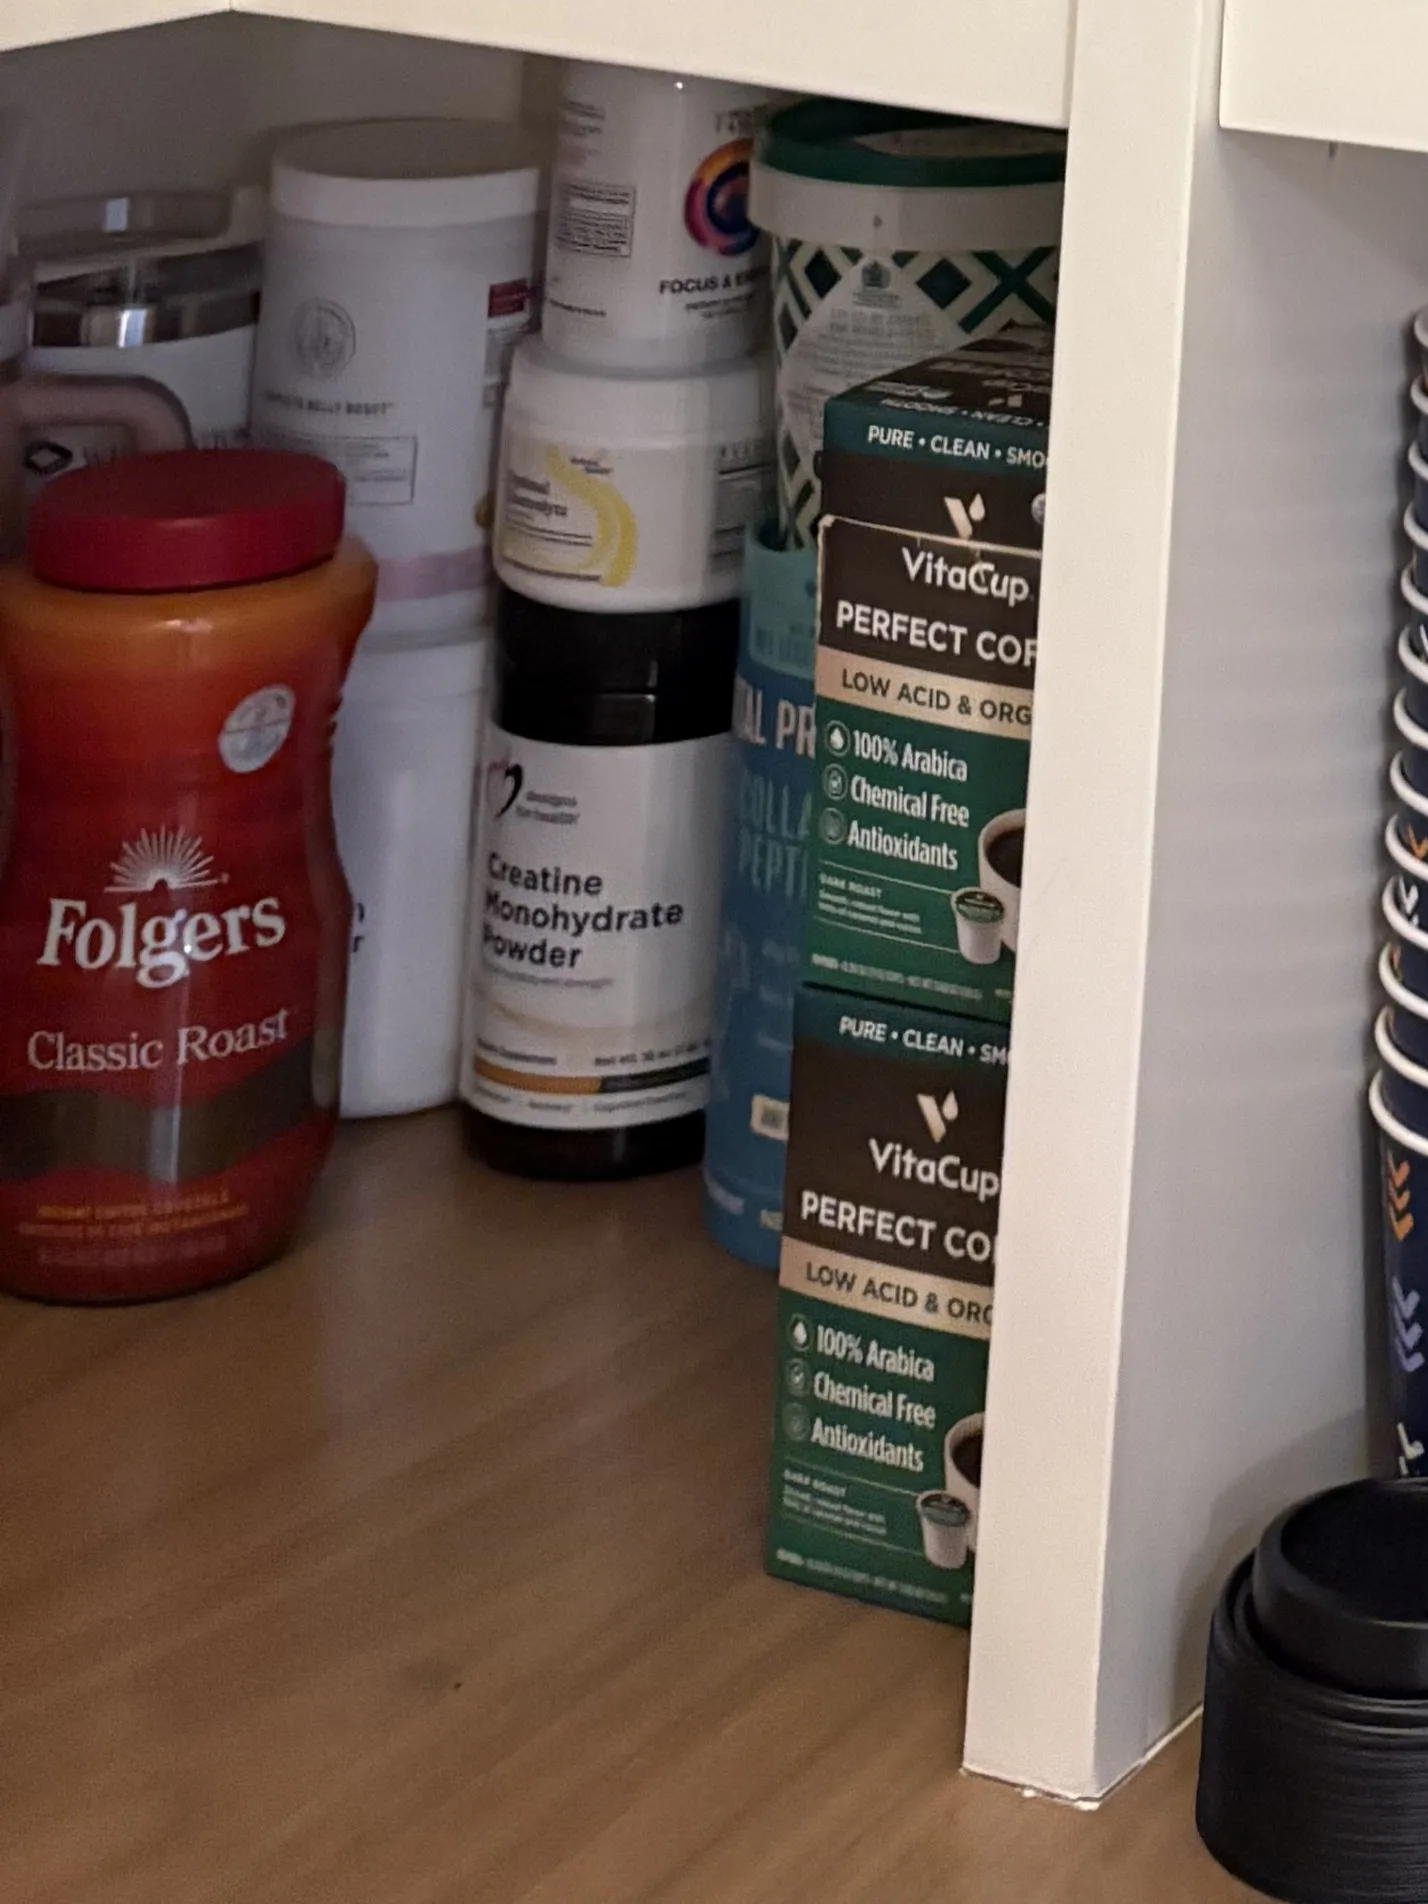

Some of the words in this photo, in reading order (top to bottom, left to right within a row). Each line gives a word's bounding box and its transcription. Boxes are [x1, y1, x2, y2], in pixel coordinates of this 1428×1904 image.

[866, 423, 915, 450] PURE
[929, 434, 991, 462] CLEAN
[901, 546, 1030, 608] VitaCup
[835, 599, 970, 658] PERFECT
[841, 667, 893, 696] LOW
[897, 678, 951, 712] ACID
[957, 693, 973, 718] &
[852, 729, 900, 768] 100%
[902, 743, 969, 784] Arabica
[849, 775, 926, 828] Chemical
[929, 793, 971, 829] Free
[488, 851, 604, 897] Creatine
[846, 819, 960, 873] Antioxidants
[484, 890, 685, 939] Monohydrate
[36, 894, 289, 992] Folgers
[482, 923, 581, 970] Powder
[26, 1029, 164, 1075] Classic
[175, 1007, 290, 1068] Roast
[838, 1015, 887, 1044] PURE
[902, 1026, 965, 1058] CLEAN
[868, 1137, 1000, 1204] VitaCup
[800, 1189, 936, 1253] PERFECT
[805, 1259, 858, 1294] LOW
[862, 1275, 919, 1312] ACID
[925, 1293, 940, 1315] &
[816, 1323, 864, 1366] 100%
[865, 1338, 936, 1383] Arabica
[812, 1371, 893, 1418] Chemical
[896, 1392, 936, 1431] Free
[811, 1416, 925, 1475] Antioxidants
